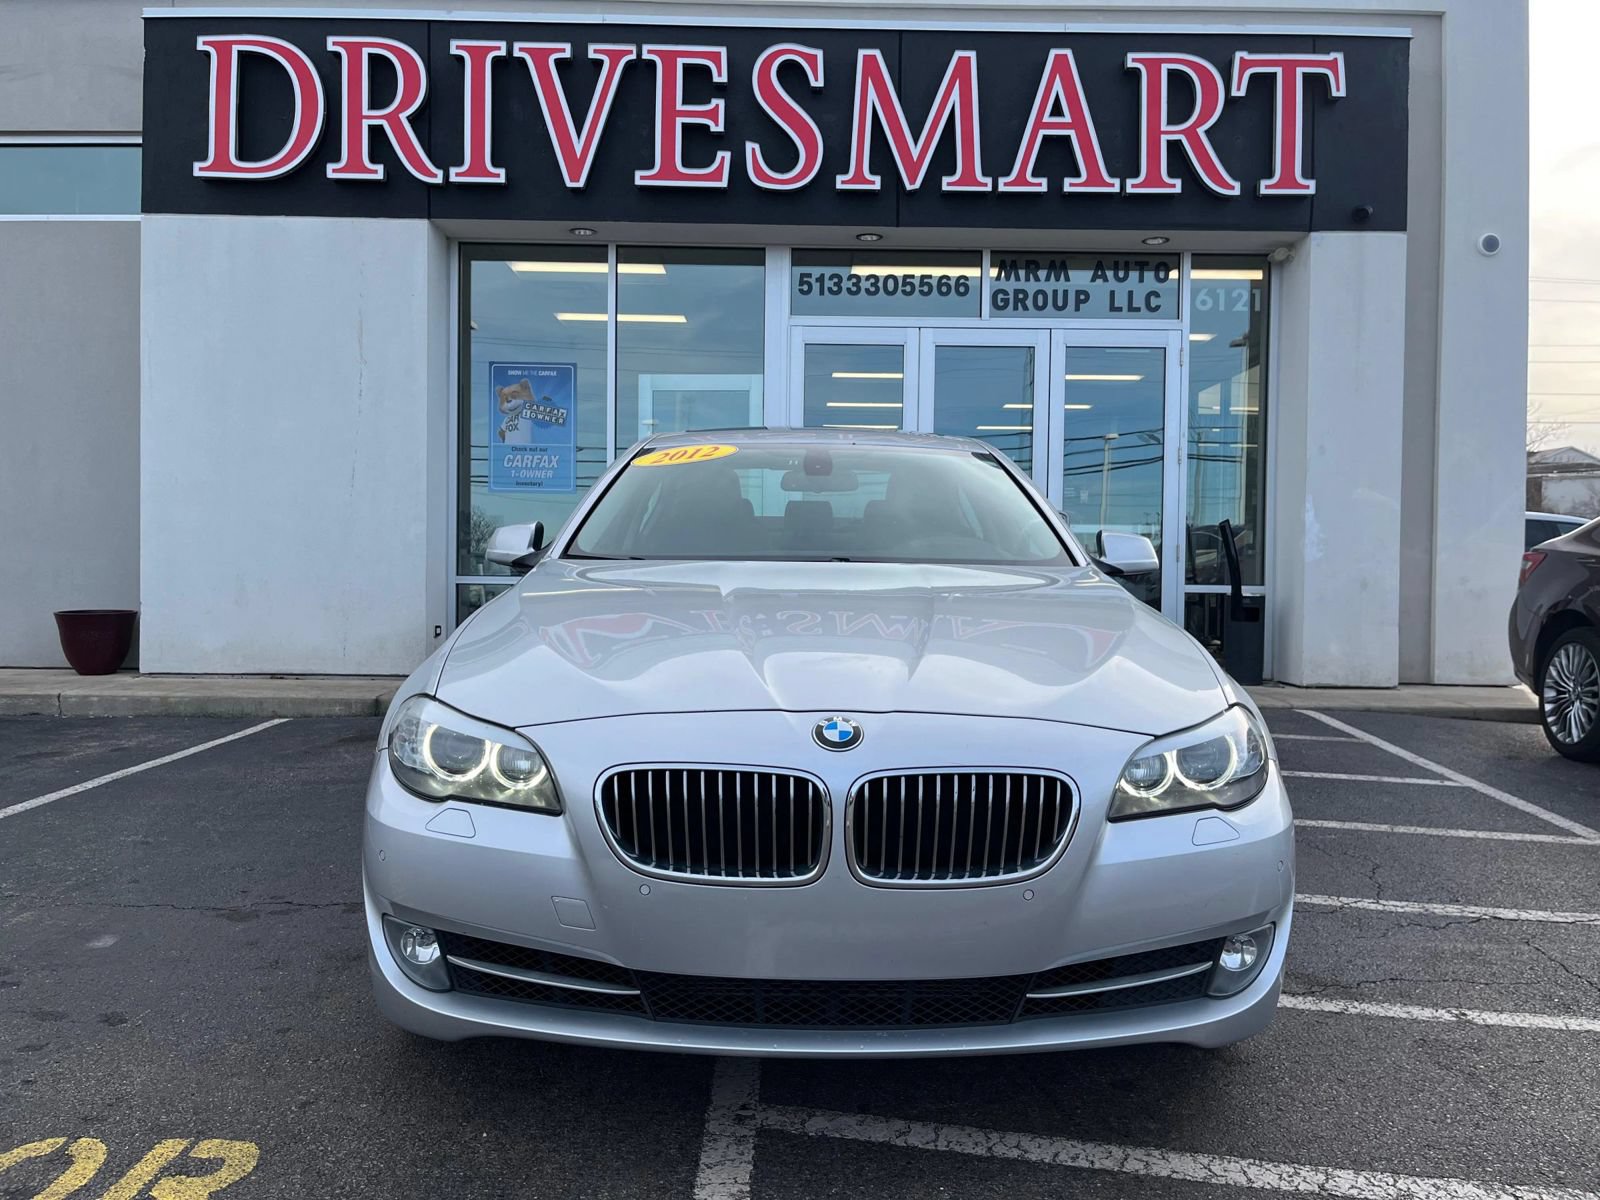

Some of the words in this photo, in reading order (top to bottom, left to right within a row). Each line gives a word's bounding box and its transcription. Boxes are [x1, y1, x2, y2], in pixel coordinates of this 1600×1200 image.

[192, 34, 1348, 197] DRIVESMART
[994, 259, 1071, 283] MRM
[1089, 260, 1171, 284] AUTO
[797, 272, 970, 297] 5133305566
[991, 288, 1091, 312] GROUP
[1108, 289, 1162, 313] LLC
[1194, 287, 1262, 312] 6121
[525, 403, 567, 418] CARFAX
[503, 454, 559, 468] CARFAX
[649, 446, 721, 464] 2012
[511, 469, 554, 479] 1-OWNER
